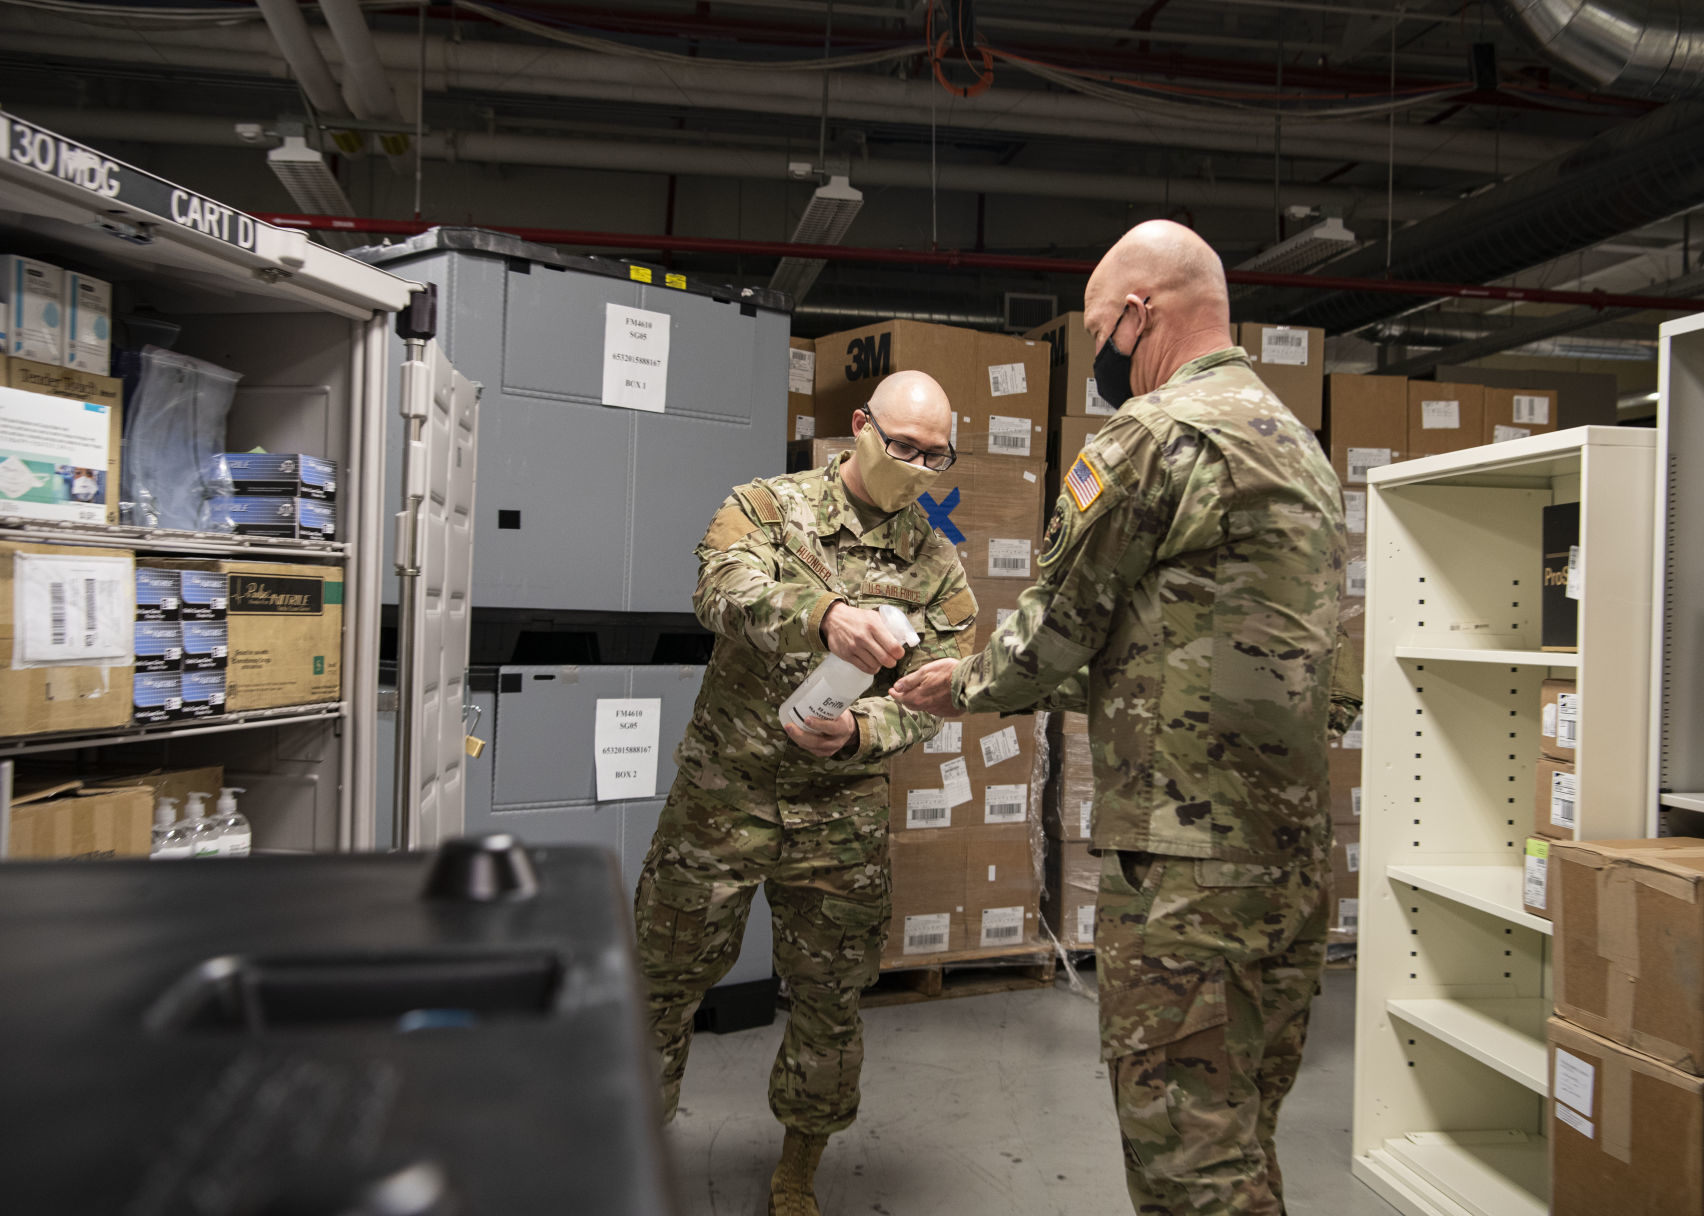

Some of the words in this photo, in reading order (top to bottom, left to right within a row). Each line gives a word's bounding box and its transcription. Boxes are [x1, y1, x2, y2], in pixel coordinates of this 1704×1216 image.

[13, 124, 55, 172] 30
[170, 188, 234, 241] CART
[238, 217, 255, 249] D
[626, 317, 652, 328] FM4610
[630, 331, 647, 340] SG05
[845, 332, 892, 381] 3M
[625, 379, 641, 389] BOX
[796, 545, 832, 582] HUONDER
[885, 585, 899, 598] AIR
[602, 746, 651, 754] 6532015888167
[633, 770, 637, 778] 2
